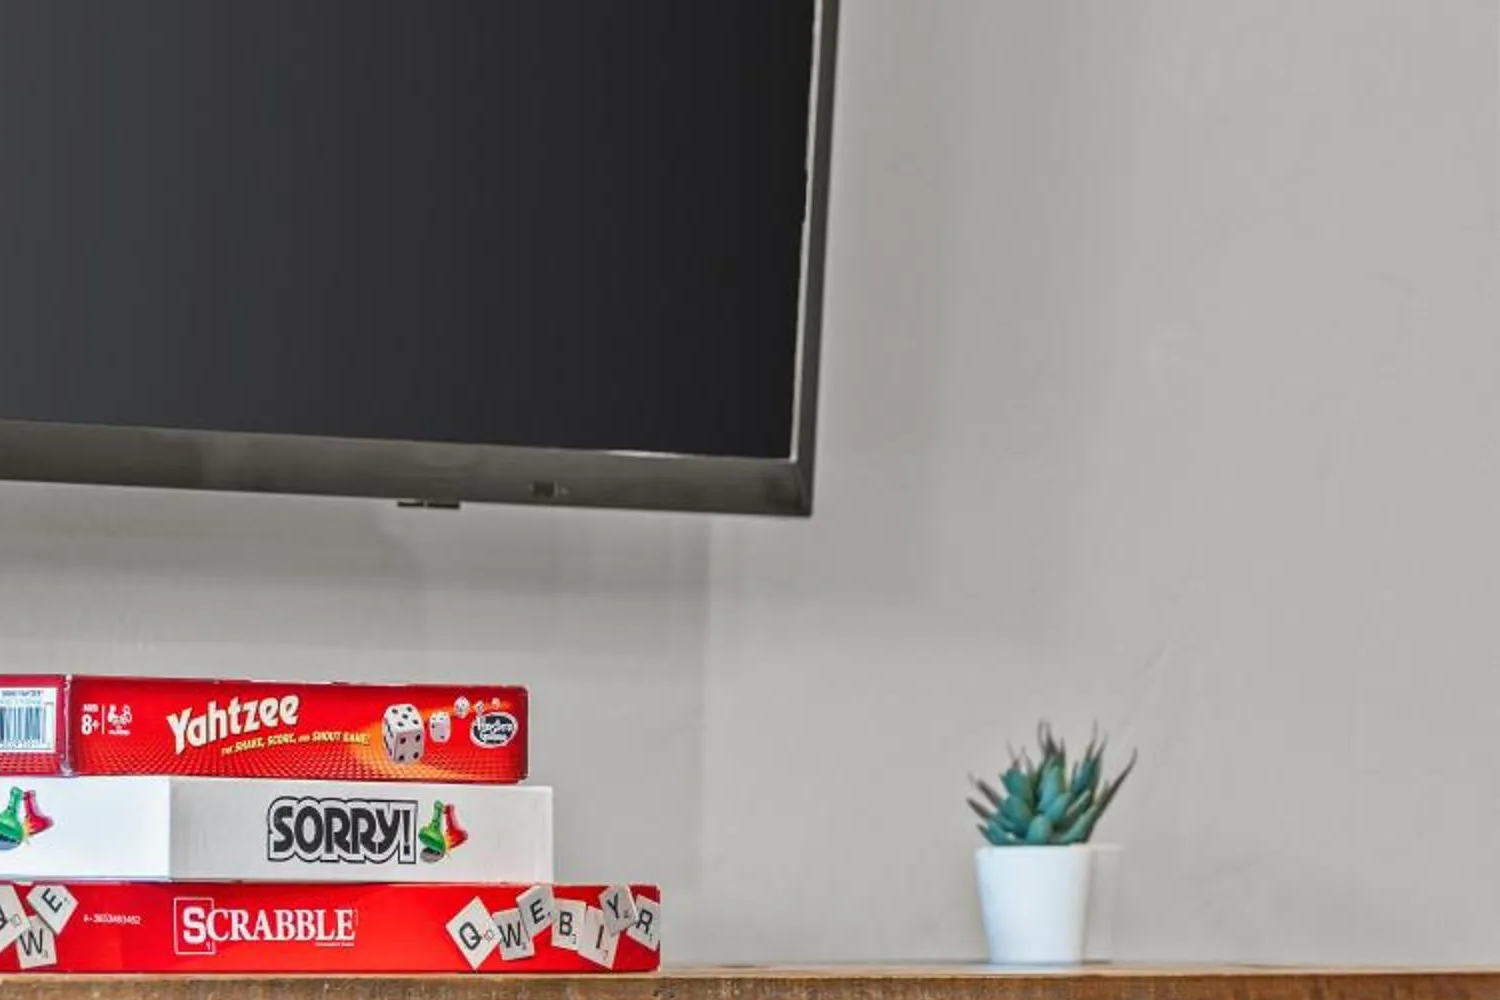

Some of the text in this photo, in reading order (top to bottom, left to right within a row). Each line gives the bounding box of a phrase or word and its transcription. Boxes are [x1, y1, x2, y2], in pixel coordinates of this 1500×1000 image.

[81, 713, 100, 736] 8+
[166, 694, 300, 755] Yahtzee
[271, 803, 413, 858] SORRY!
[41, 887, 63, 914] E
[19, 928, 43, 956] W
[182, 907, 356, 945] SCRABBLE
